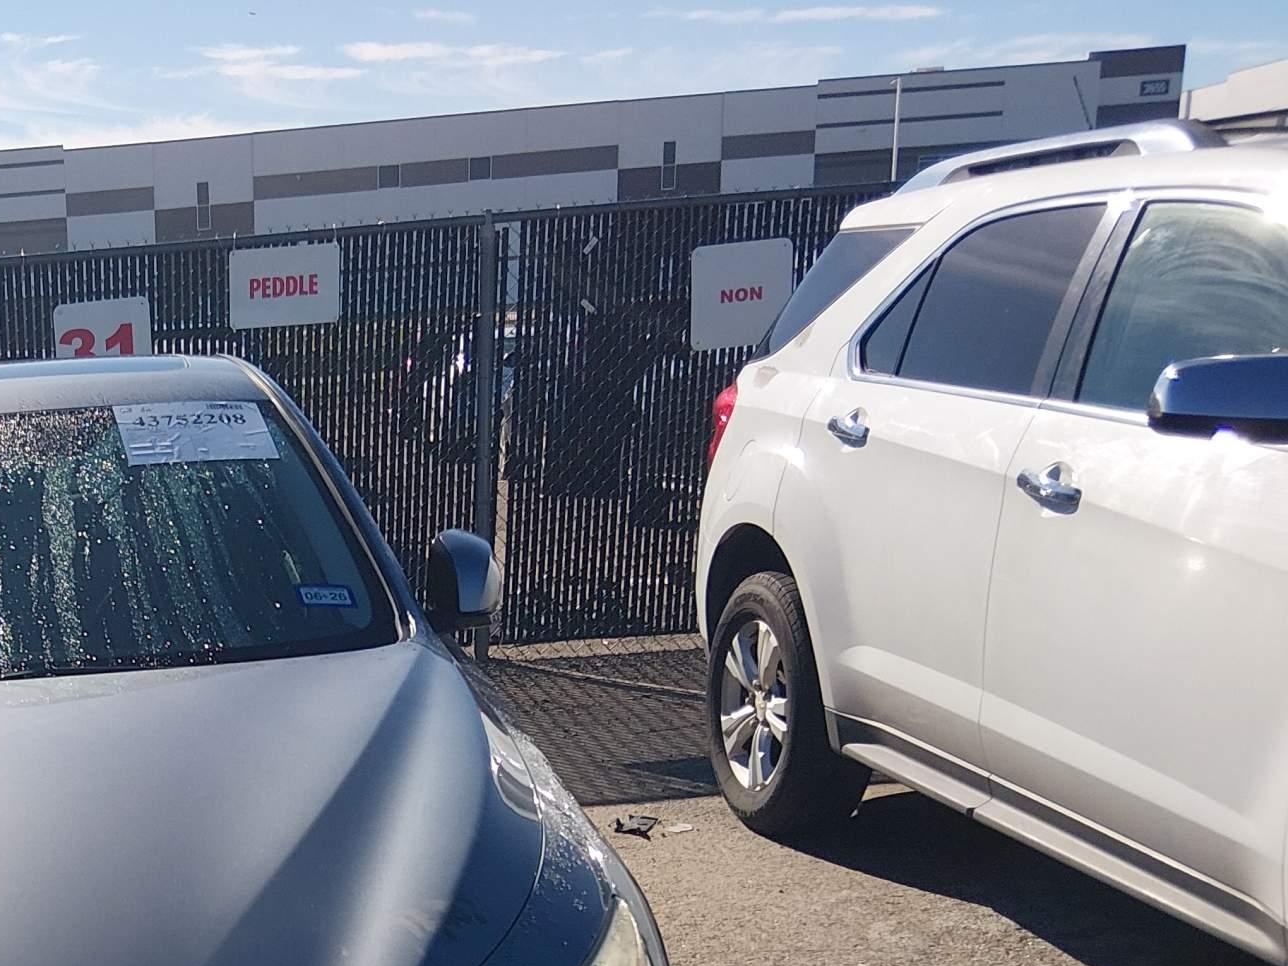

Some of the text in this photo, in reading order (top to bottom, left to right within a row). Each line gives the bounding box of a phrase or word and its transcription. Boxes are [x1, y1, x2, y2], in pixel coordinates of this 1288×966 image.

[249, 273, 318, 299] PEDDLE
[720, 286, 763, 303] NON
[59, 322, 134, 358] 31
[133, 412, 247, 427] 43752208
